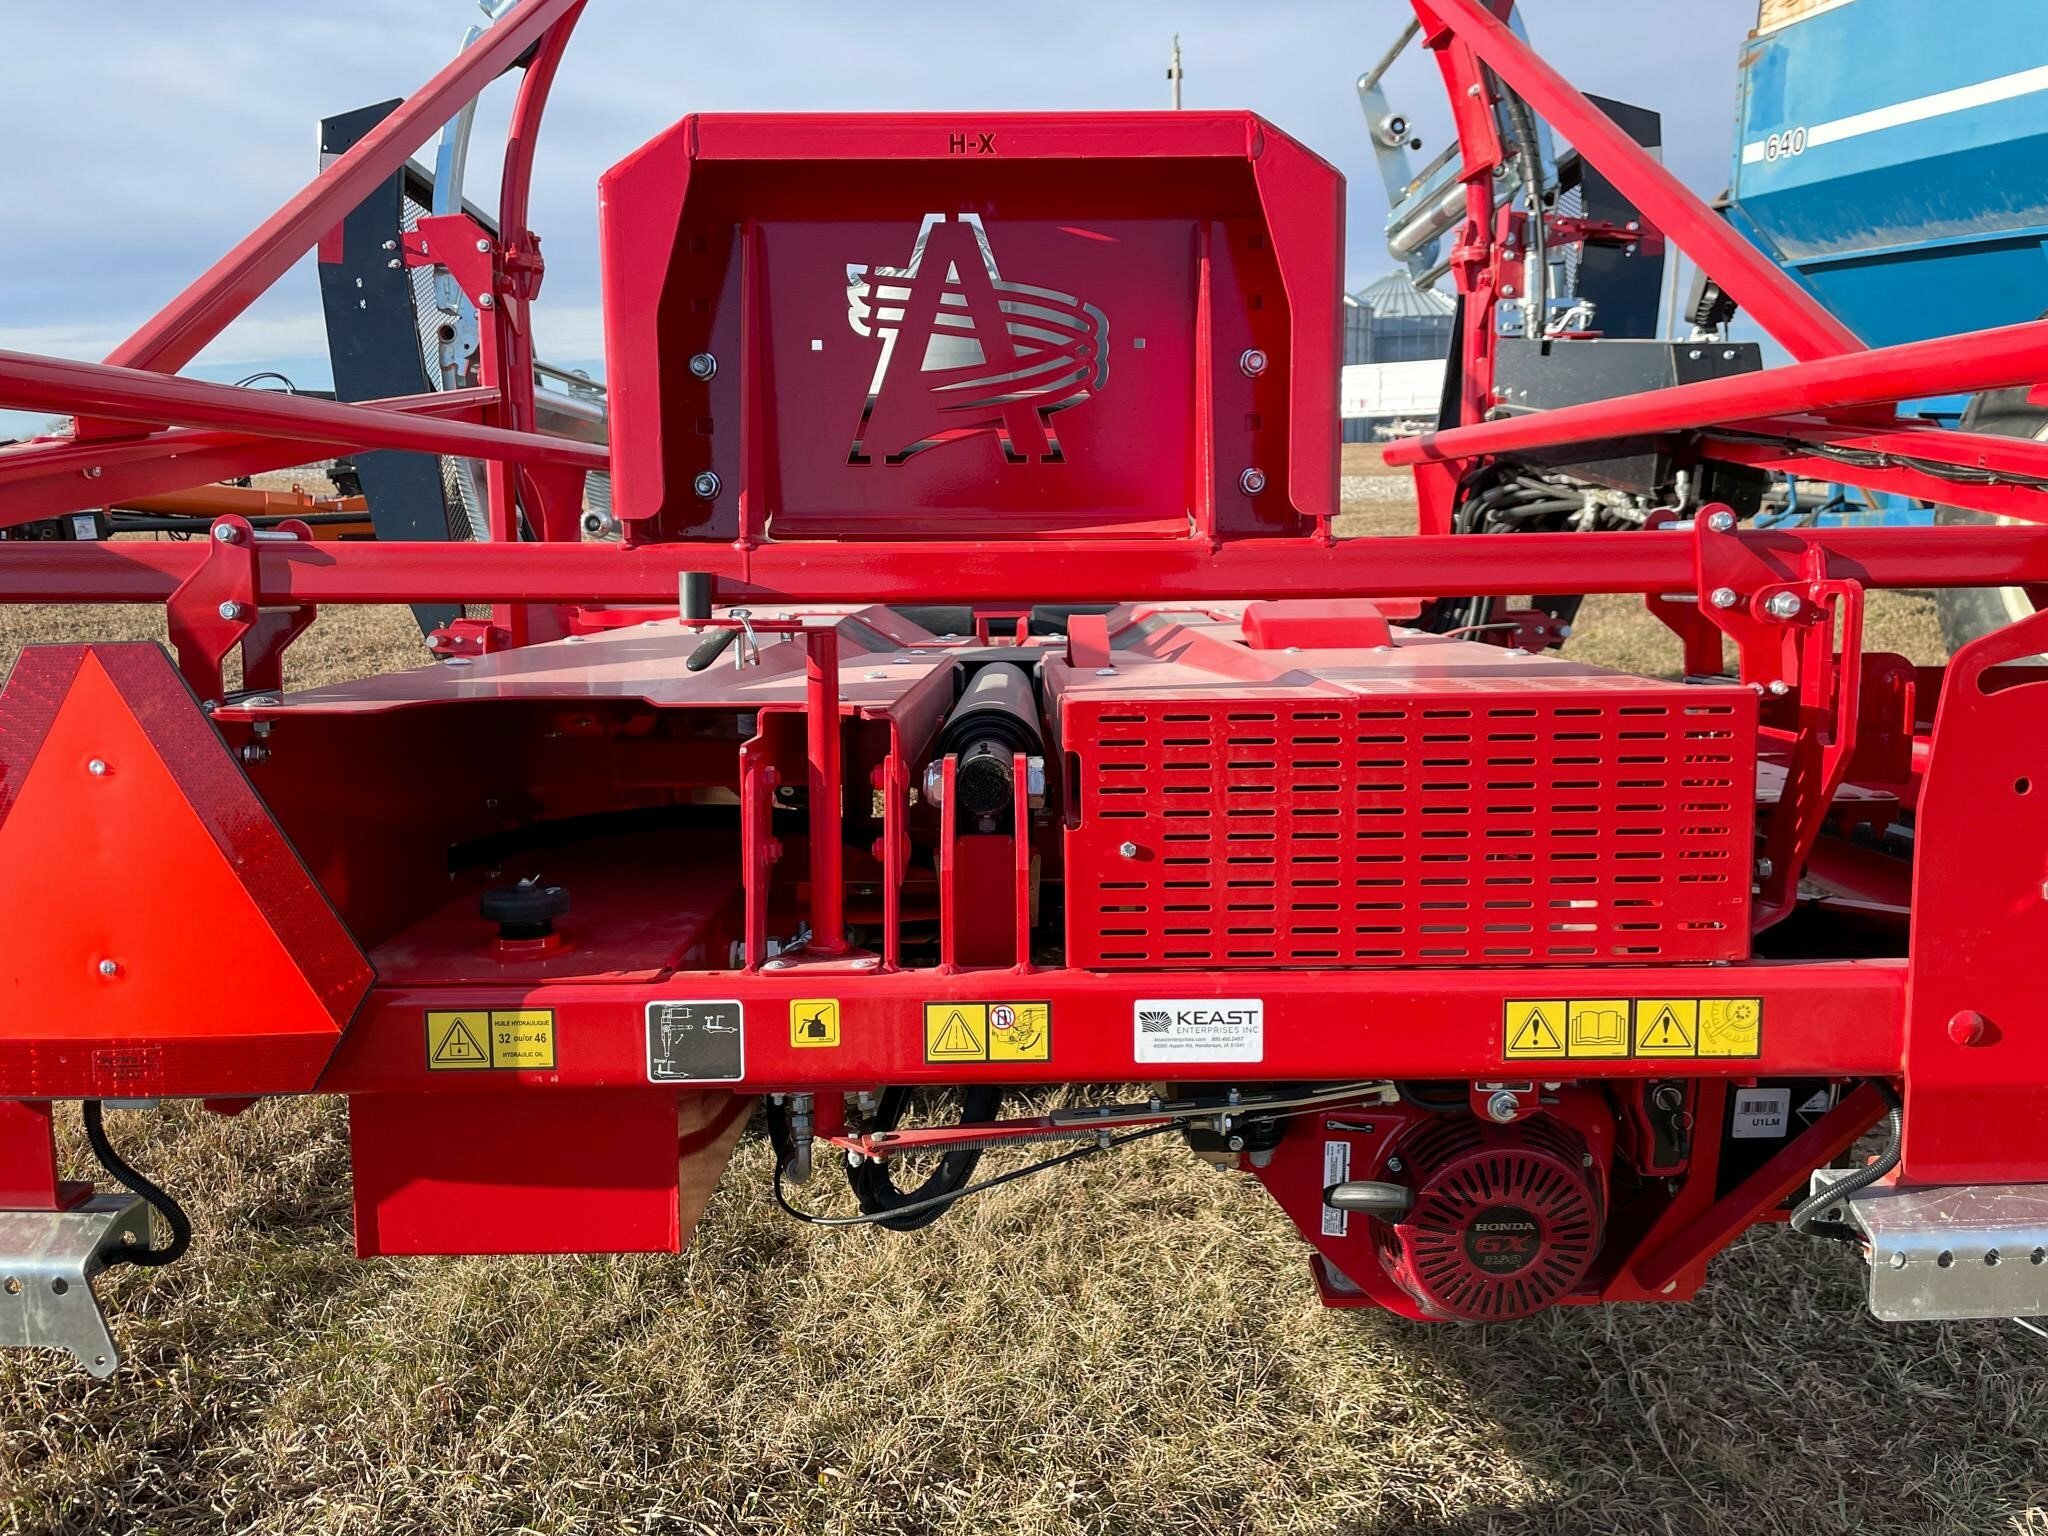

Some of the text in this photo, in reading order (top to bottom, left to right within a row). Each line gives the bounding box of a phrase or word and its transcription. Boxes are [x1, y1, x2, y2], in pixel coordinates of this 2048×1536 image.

[949, 133, 996, 154] H-X
[1765, 126, 1808, 162] 640
[1177, 1010, 1259, 1025] KEAST
[1176, 1026, 1239, 1034] ENTERPRISES
[498, 1033, 547, 1043] 32 ou/or 46
[1752, 1118, 1780, 1126] U1LM
[1474, 1222, 1537, 1231] HONDA
[1474, 1234, 1534, 1254] GX
